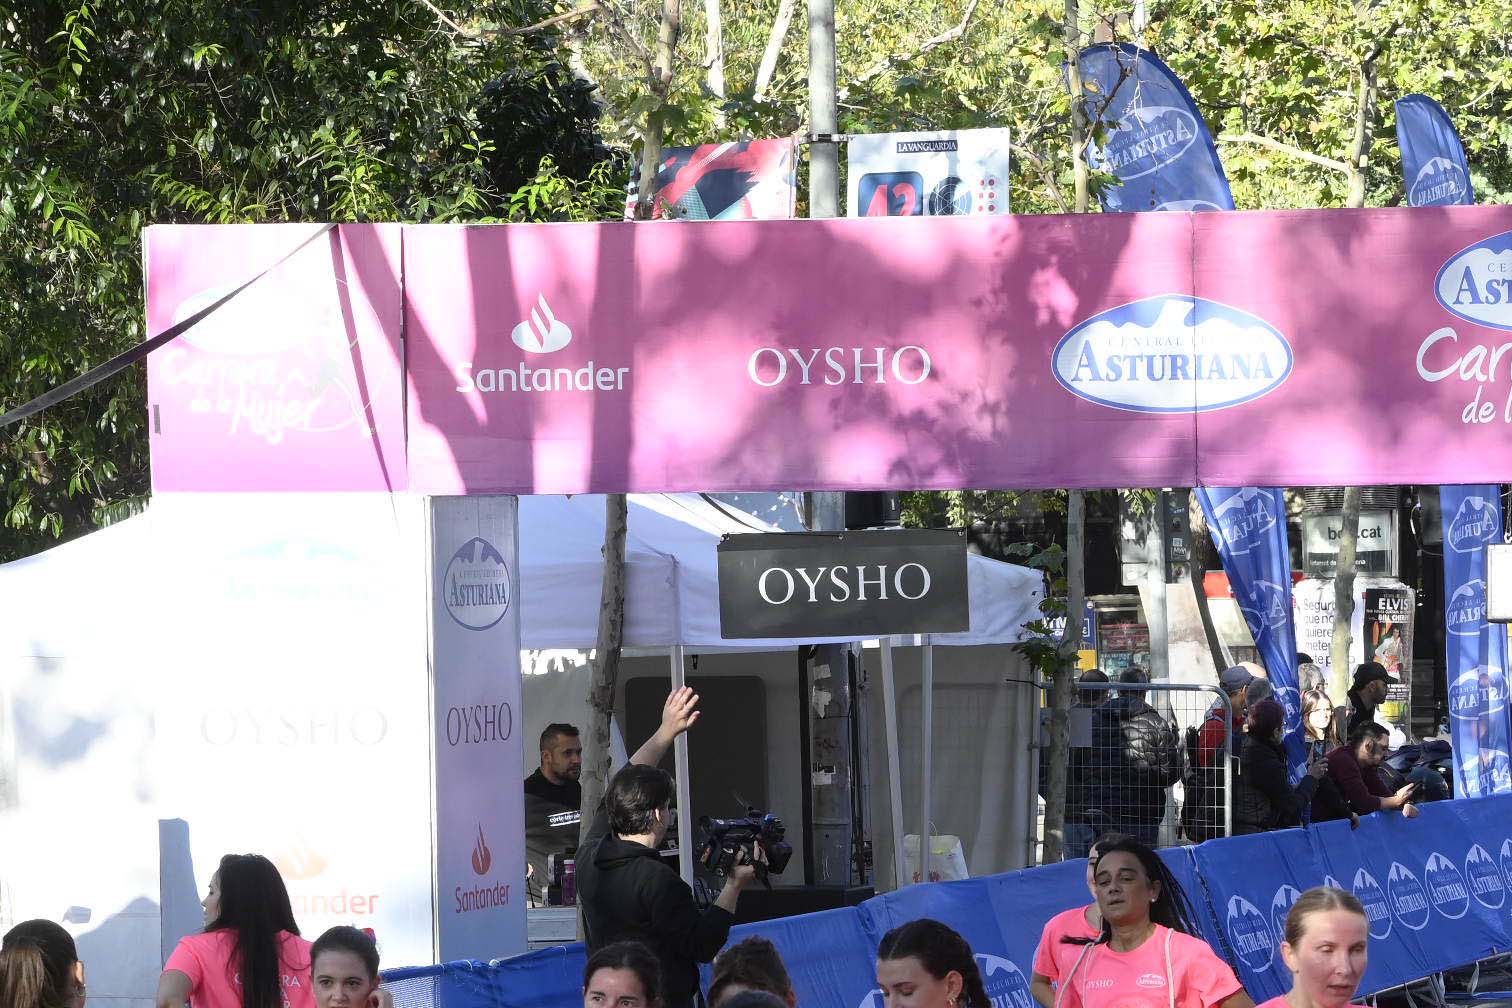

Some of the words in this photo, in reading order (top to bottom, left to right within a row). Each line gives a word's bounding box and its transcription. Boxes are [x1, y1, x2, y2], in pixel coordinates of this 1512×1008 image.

[456, 360, 629, 394] Santander
[747, 345, 931, 387] OYSHO
[1070, 339, 1275, 383] ASTURIANA
[1462, 384, 1496, 424] de
[448, 572, 507, 607] ASTURIANA
[758, 562, 931, 605] OYSHO
[1378, 597, 1409, 611] ELVIS
[446, 702, 513, 747] OYSHO
[455, 880, 511, 914] Santander
